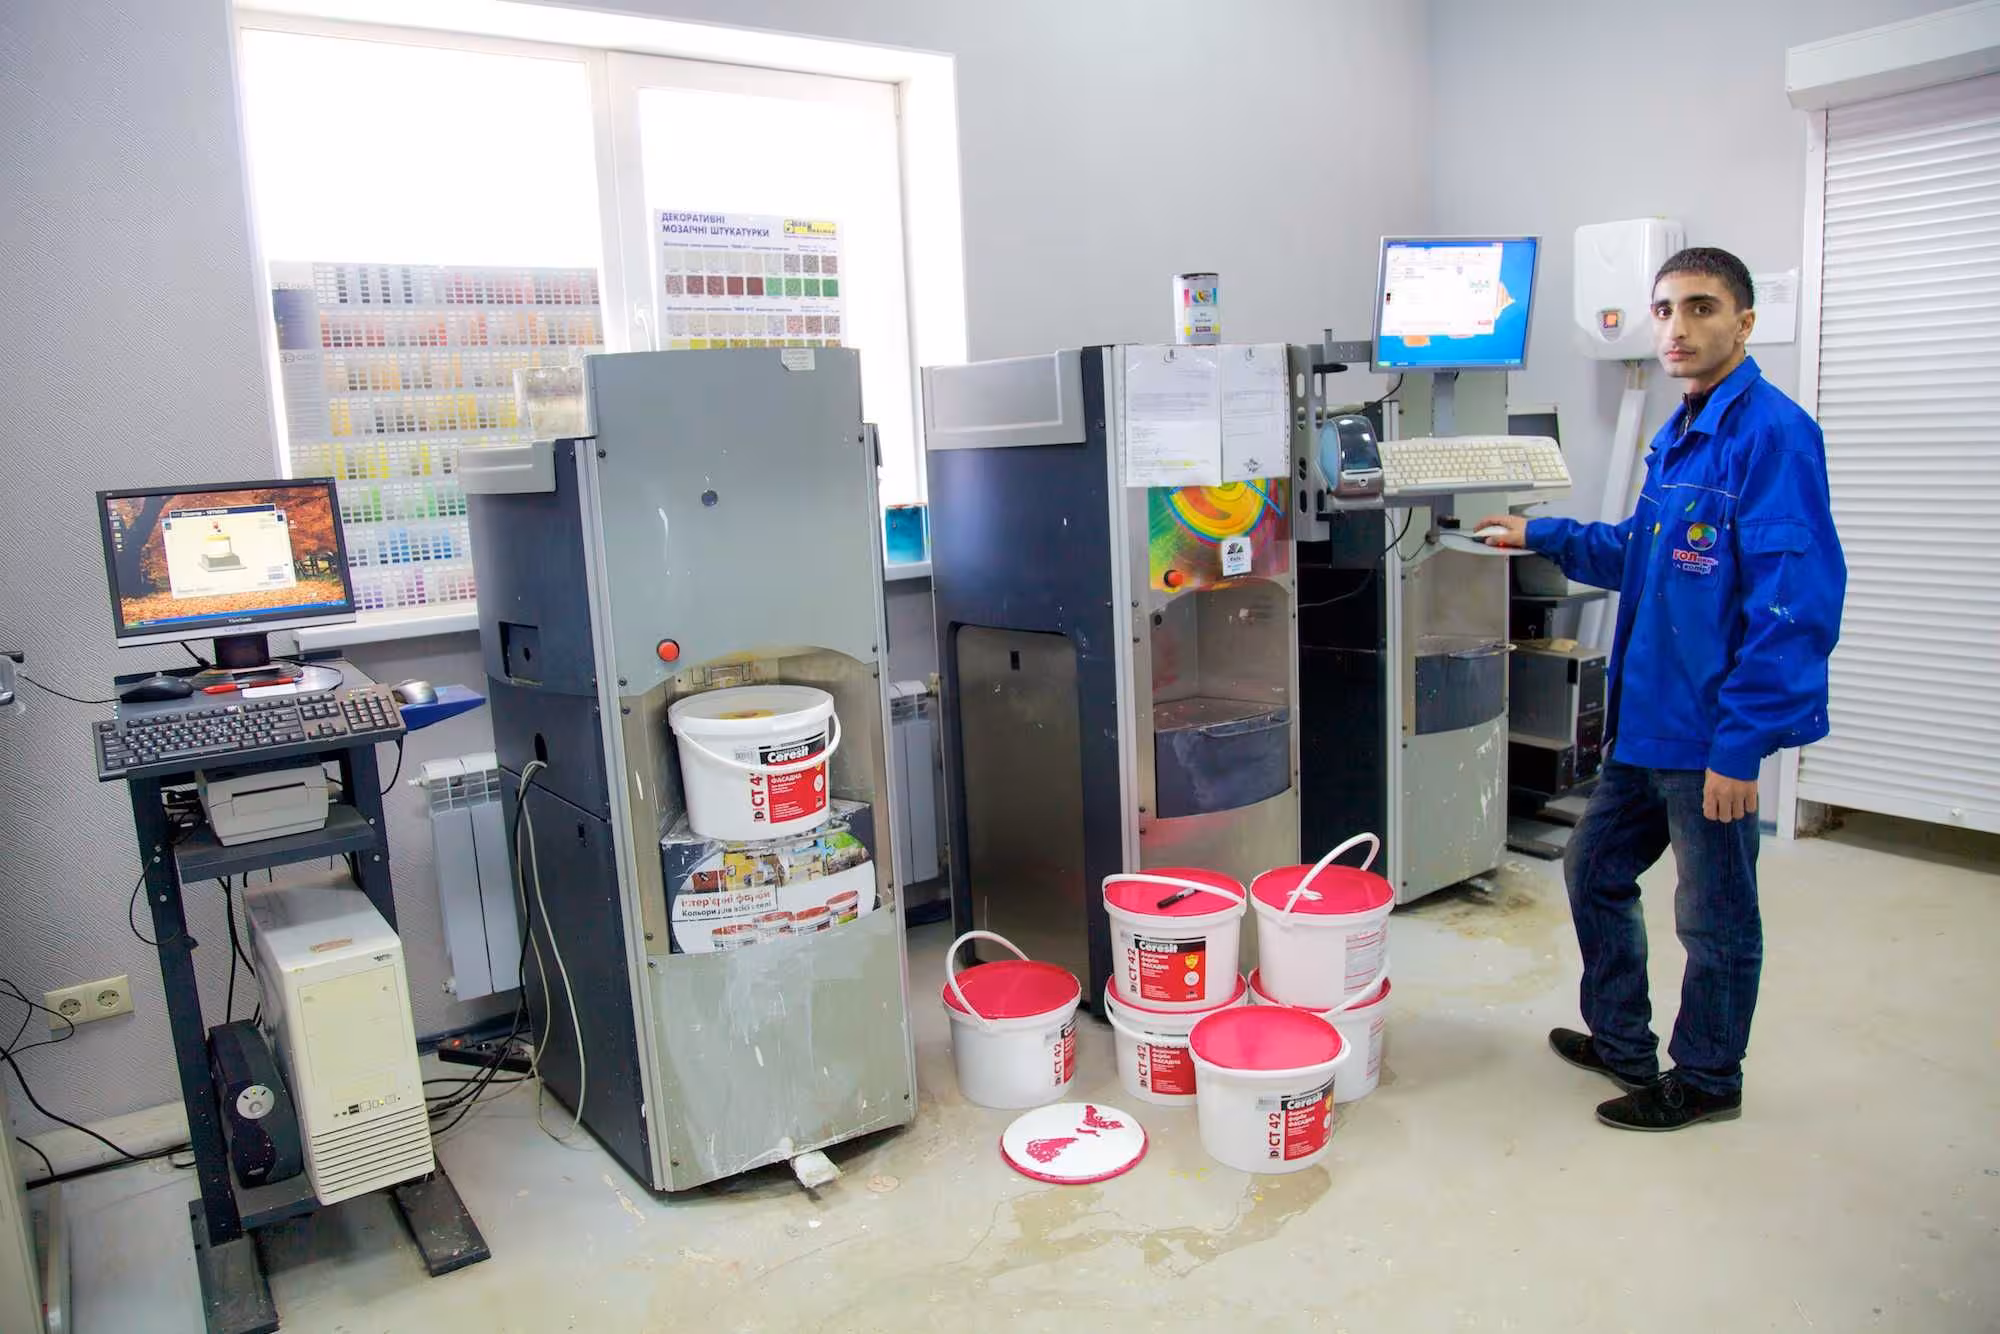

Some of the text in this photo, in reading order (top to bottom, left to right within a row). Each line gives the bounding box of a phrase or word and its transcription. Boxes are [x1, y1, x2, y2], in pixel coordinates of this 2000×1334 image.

[662, 213, 725, 224] ДЕКОРАТИВНІ
[711, 227, 769, 238] ШТУКАТУРКИ
[767, 745, 809, 763] Ceresit
[1138, 940, 1178, 953] Ceresit
[1286, 1091, 1322, 1110] Ceresit
[1269, 1112, 1280, 1129] 42
